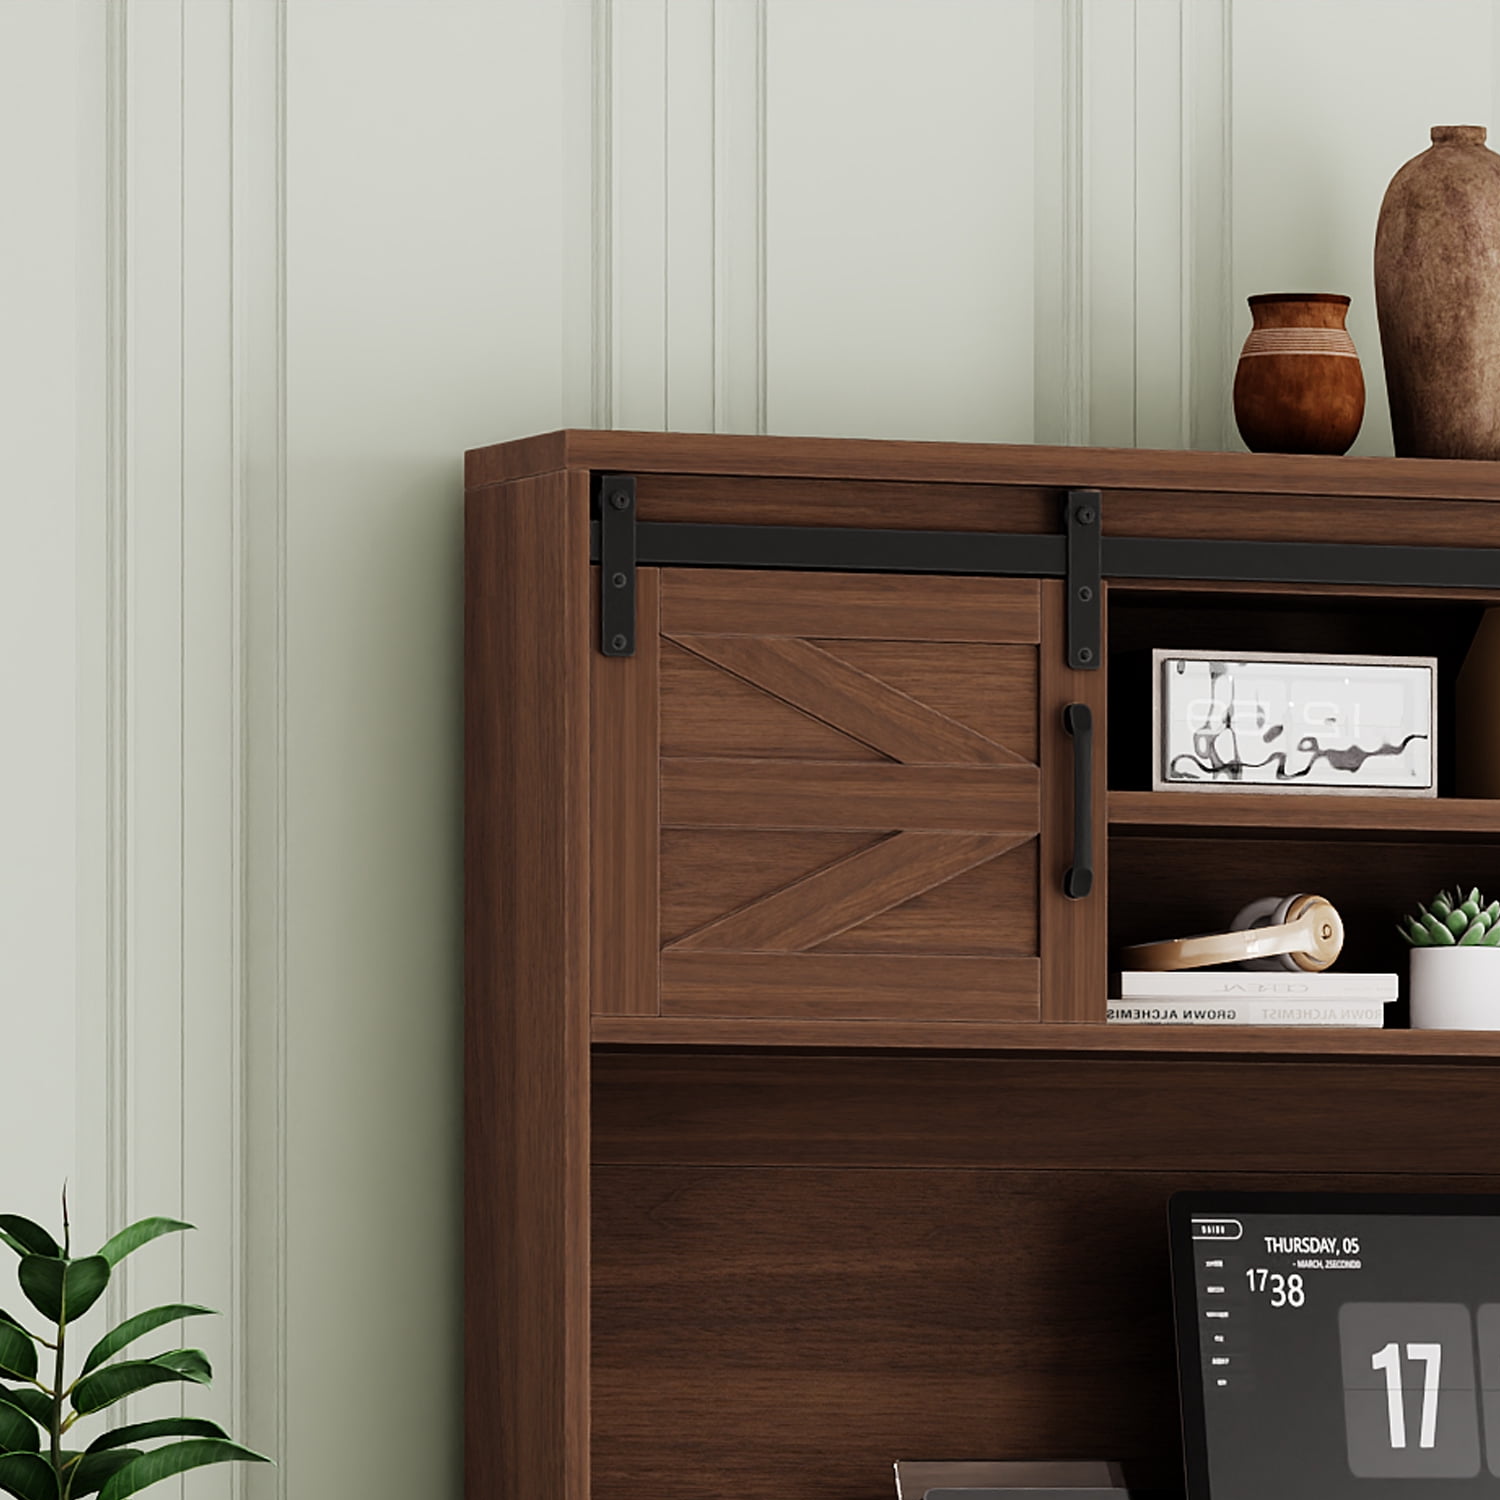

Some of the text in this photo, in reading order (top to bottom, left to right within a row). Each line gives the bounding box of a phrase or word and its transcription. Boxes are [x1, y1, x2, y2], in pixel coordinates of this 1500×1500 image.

[1264, 1236, 1360, 1256] THURSDAY, 05
[1246, 1269, 1305, 1308] 17 38
[1371, 1343, 1442, 1448] 17
